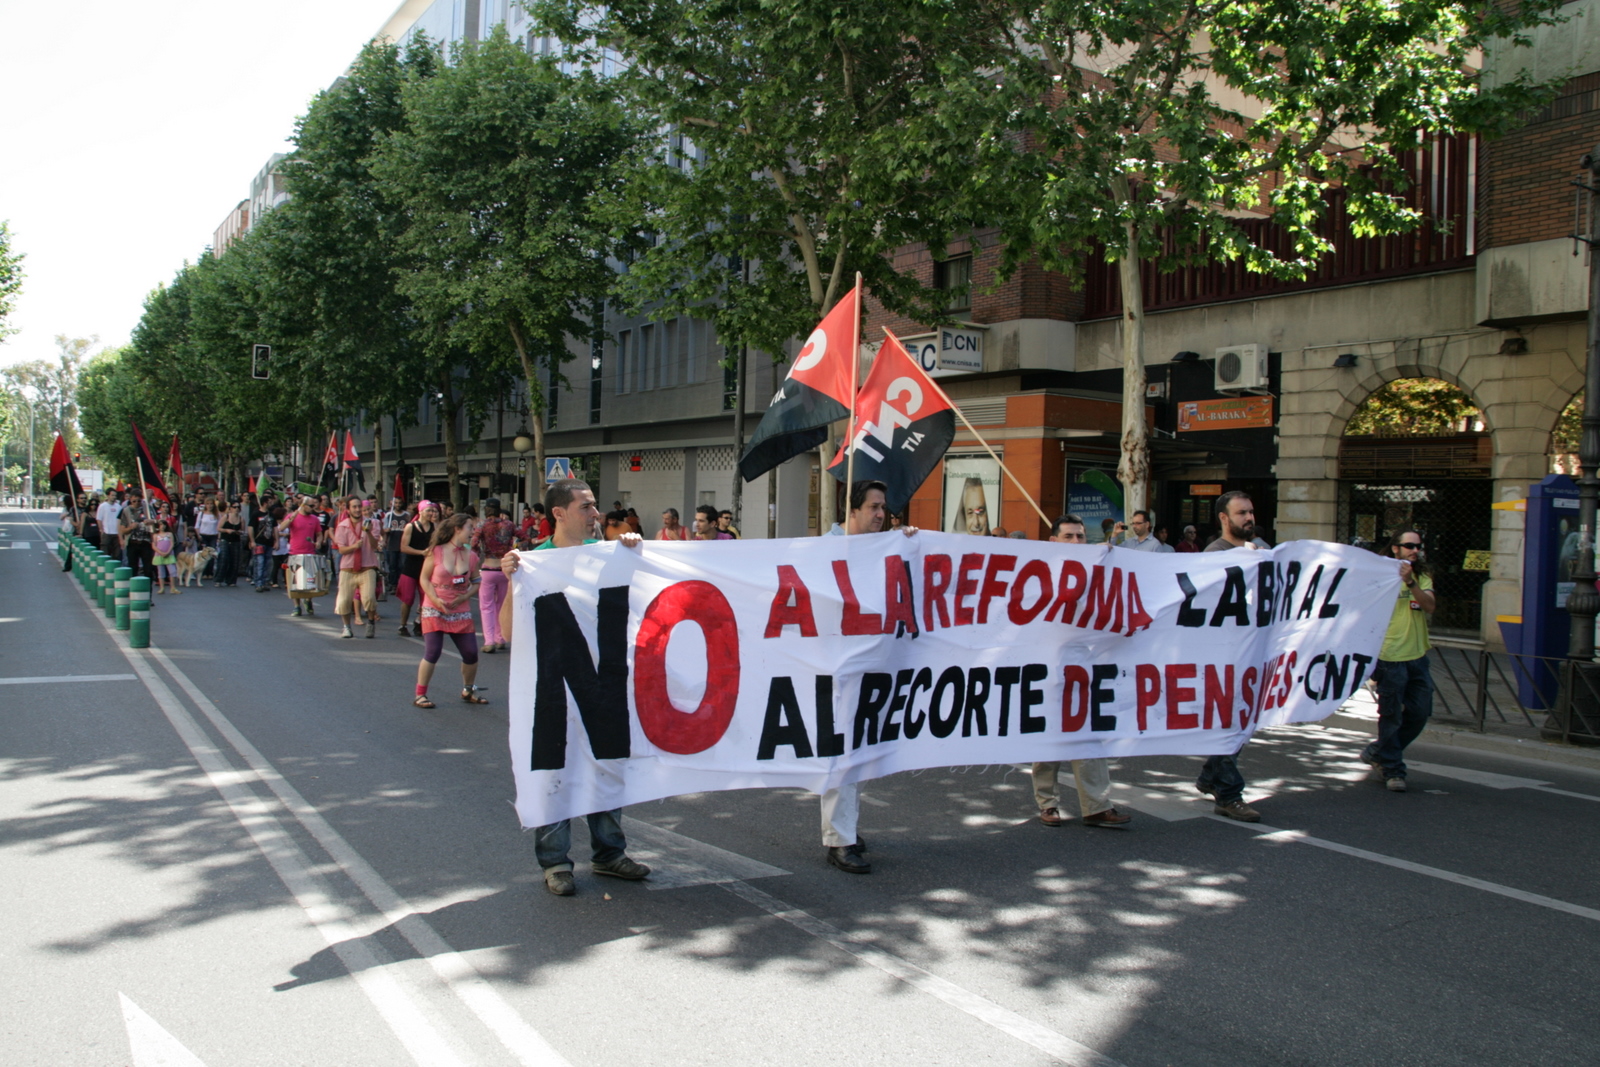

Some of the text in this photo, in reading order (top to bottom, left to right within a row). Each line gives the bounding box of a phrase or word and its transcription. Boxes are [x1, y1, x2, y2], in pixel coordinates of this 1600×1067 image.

[941, 358, 981, 368] www.cnisa.es
[954, 334, 981, 352] CNI
[1196, 410, 1247, 422] AL-BARAKA
[764, 565, 819, 639] A
[923, 552, 1154, 637] REFORMA
[531, 579, 740, 771] NO
[756, 675, 845, 761] AL
[852, 663, 1048, 751] RECORTE
[1061, 663, 1119, 733] DE
